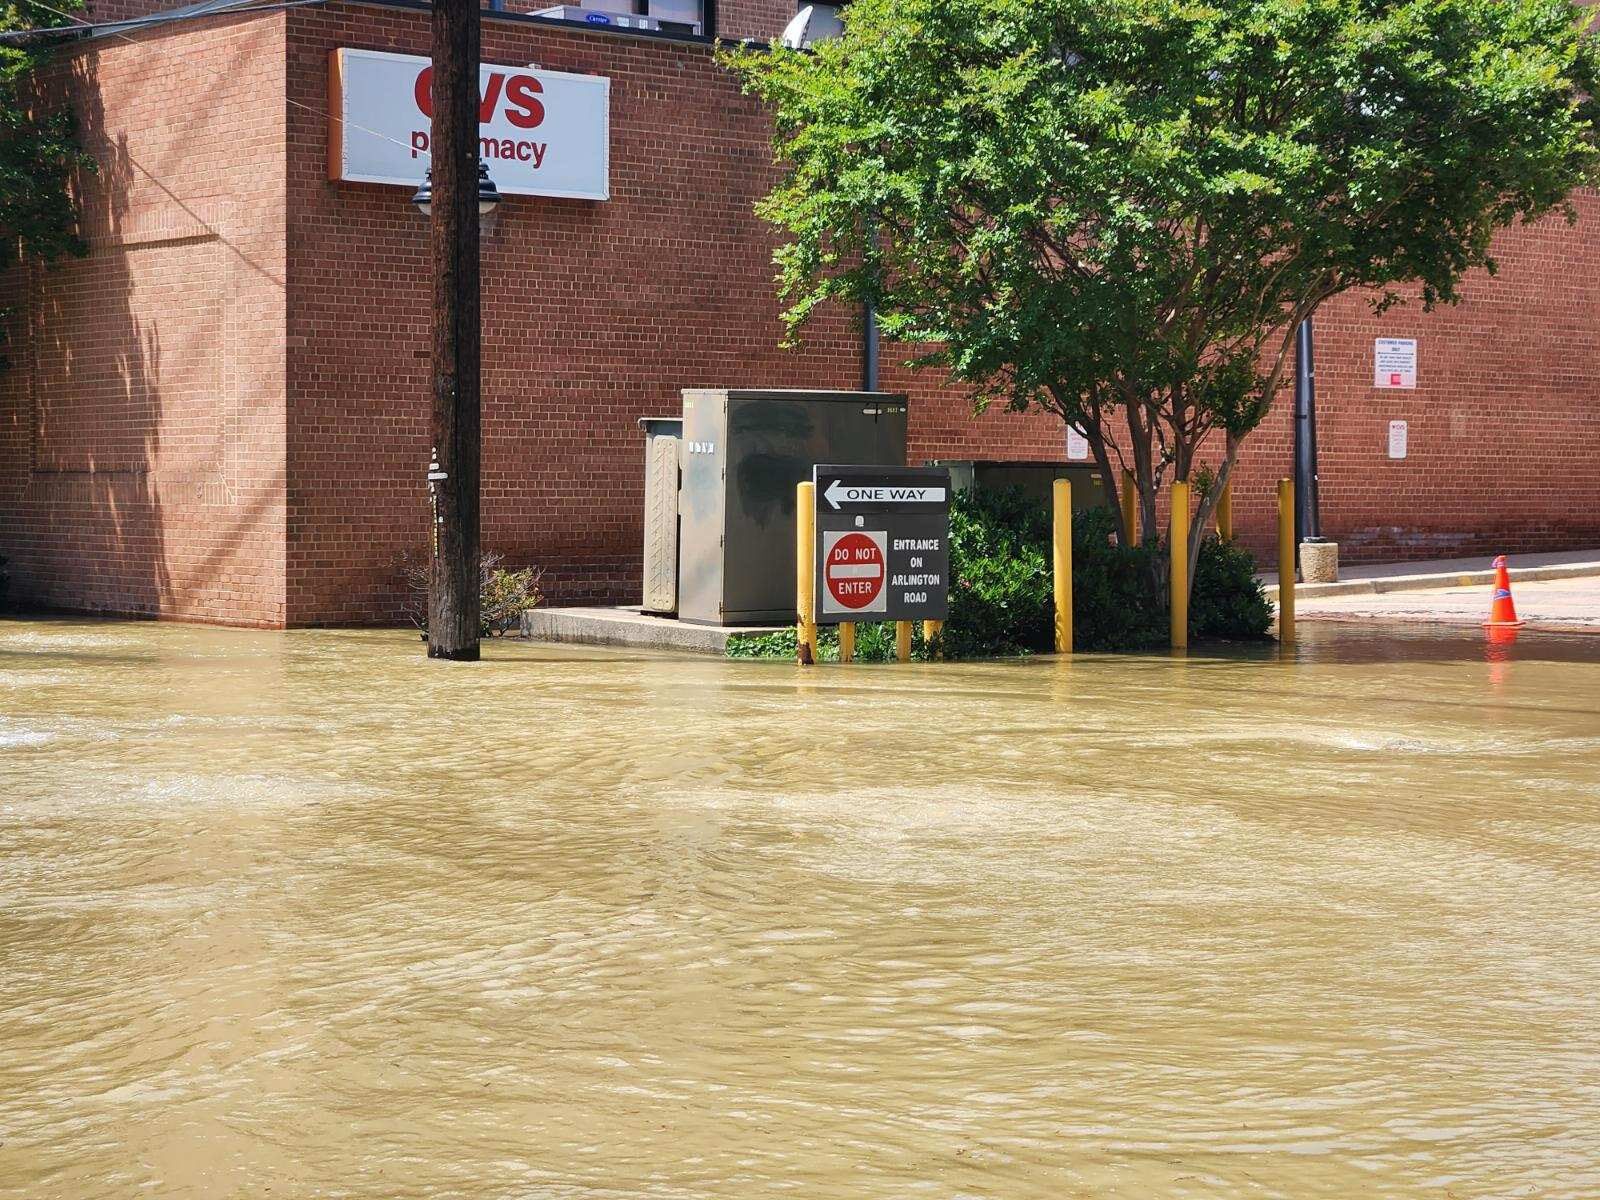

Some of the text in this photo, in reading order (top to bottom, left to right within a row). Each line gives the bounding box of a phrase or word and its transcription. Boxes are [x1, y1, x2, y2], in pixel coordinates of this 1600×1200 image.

[411, 131, 547, 169] pmacy
[847, 489, 927, 500] ONE WAY
[893, 539, 940, 551] ENTRANCE
[835, 548, 877, 561] DO NOT
[910, 557, 923, 568] ON
[891, 574, 940, 586] ARLINGTON
[838, 582, 872, 595] ENTER
[904, 592, 928, 603] ROAD
